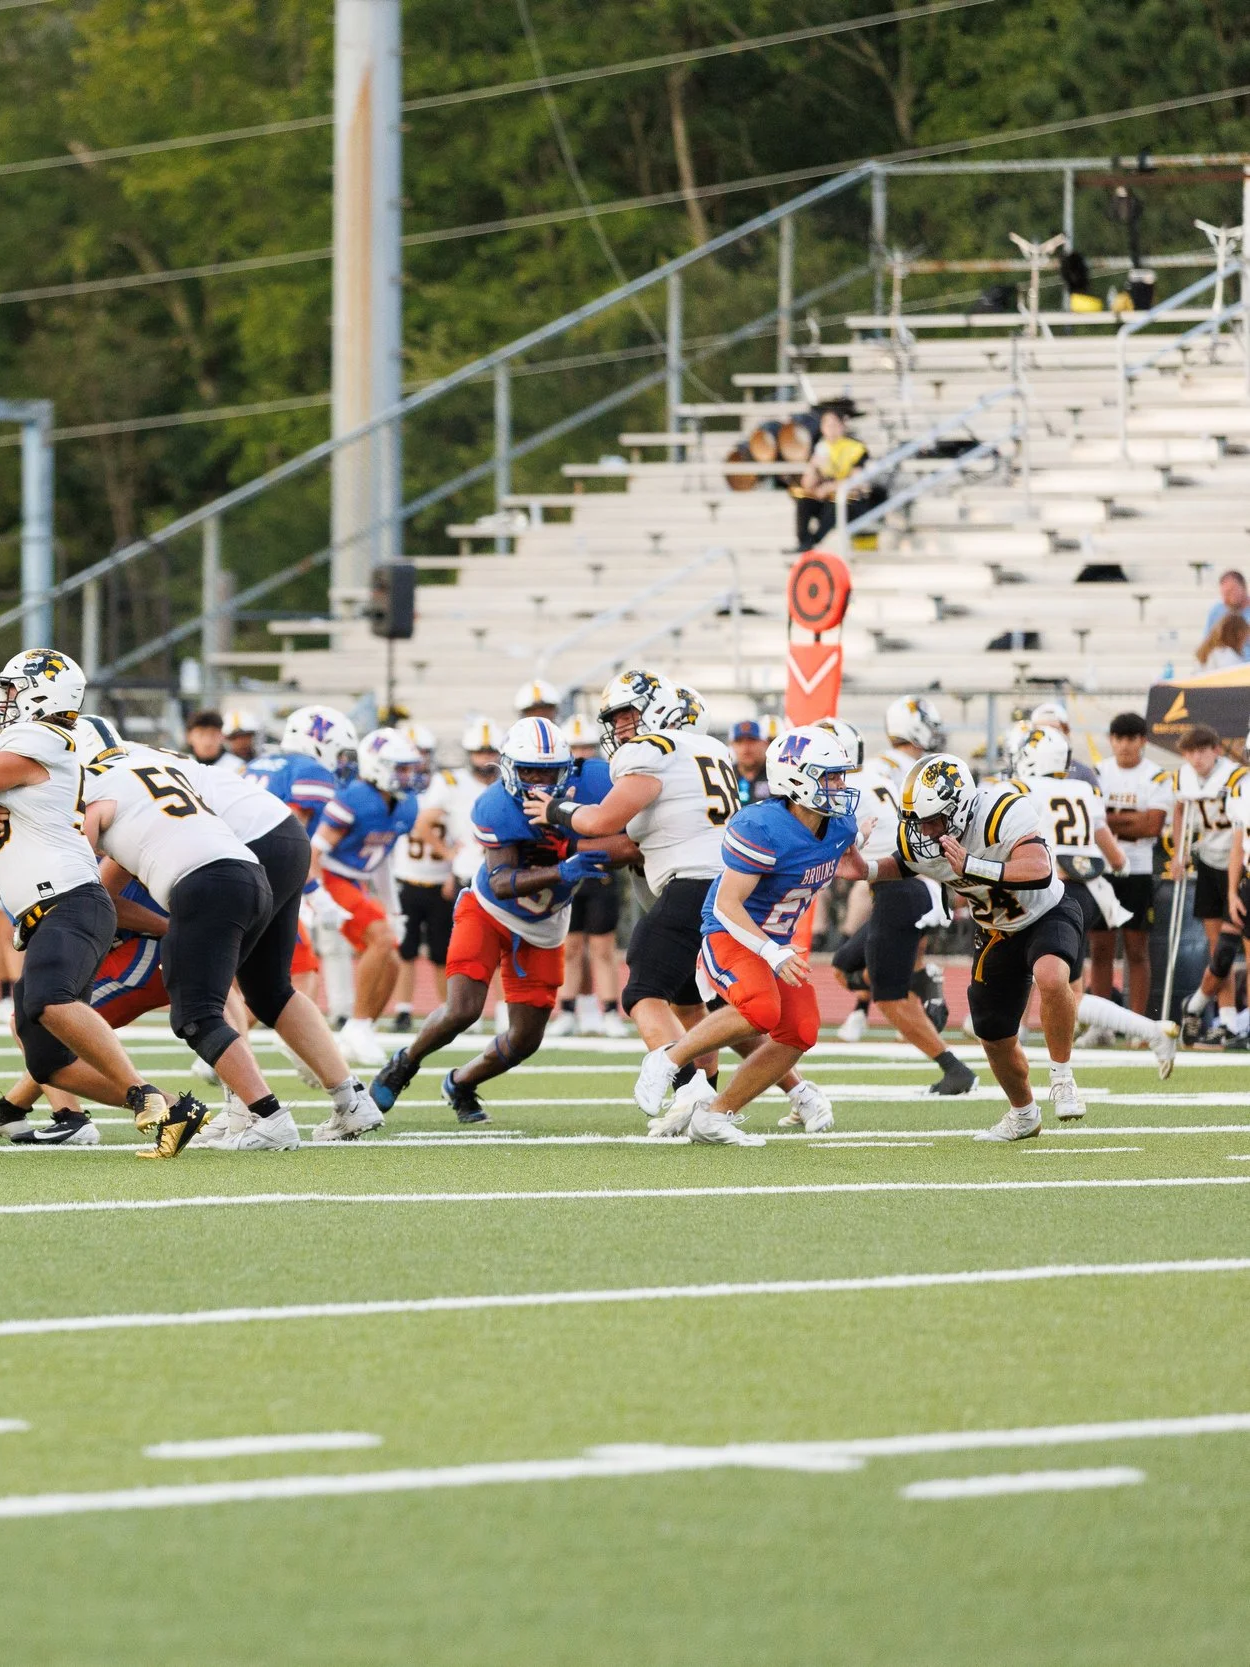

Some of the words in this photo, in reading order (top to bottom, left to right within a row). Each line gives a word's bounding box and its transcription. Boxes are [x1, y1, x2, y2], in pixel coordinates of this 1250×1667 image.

[308, 714, 334, 742] N
[778, 735, 812, 766] N
[1050, 796, 1091, 847] 21
[801, 859, 836, 885] BRUINS
